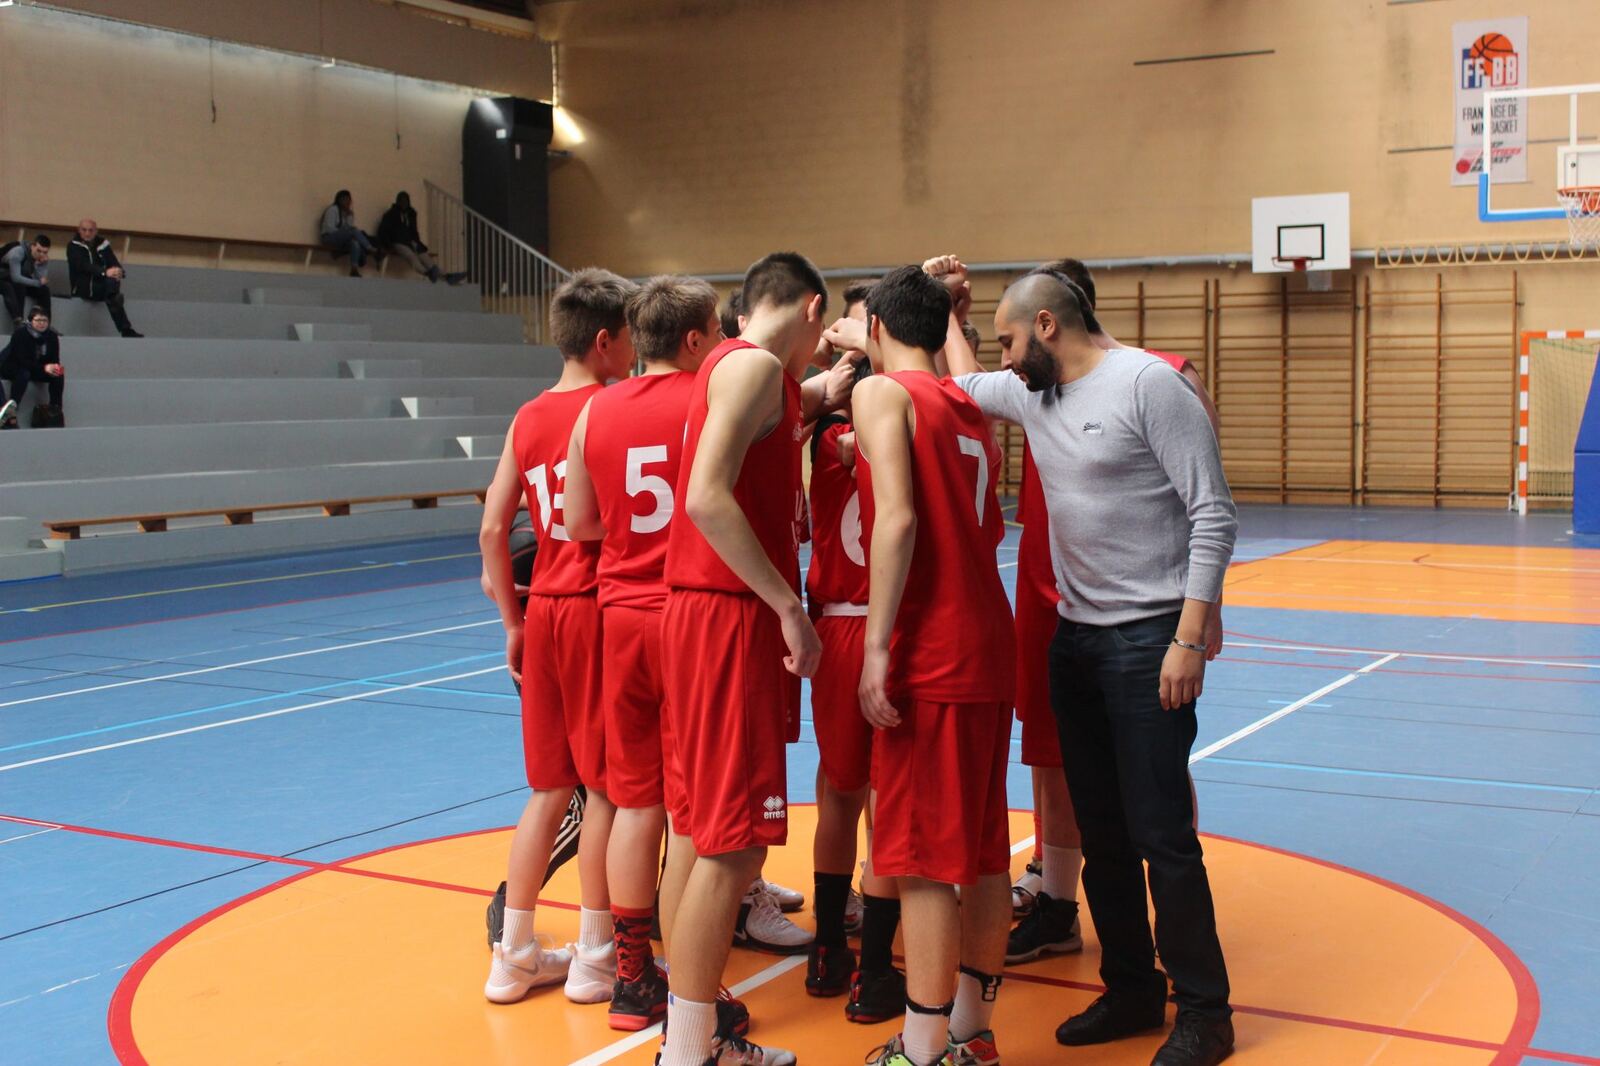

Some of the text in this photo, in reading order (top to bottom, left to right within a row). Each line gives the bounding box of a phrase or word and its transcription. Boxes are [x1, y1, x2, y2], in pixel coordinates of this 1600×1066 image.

[1462, 104, 1506, 120] FRANAISE
[625, 444, 675, 534] 5
[957, 435, 989, 527] 7
